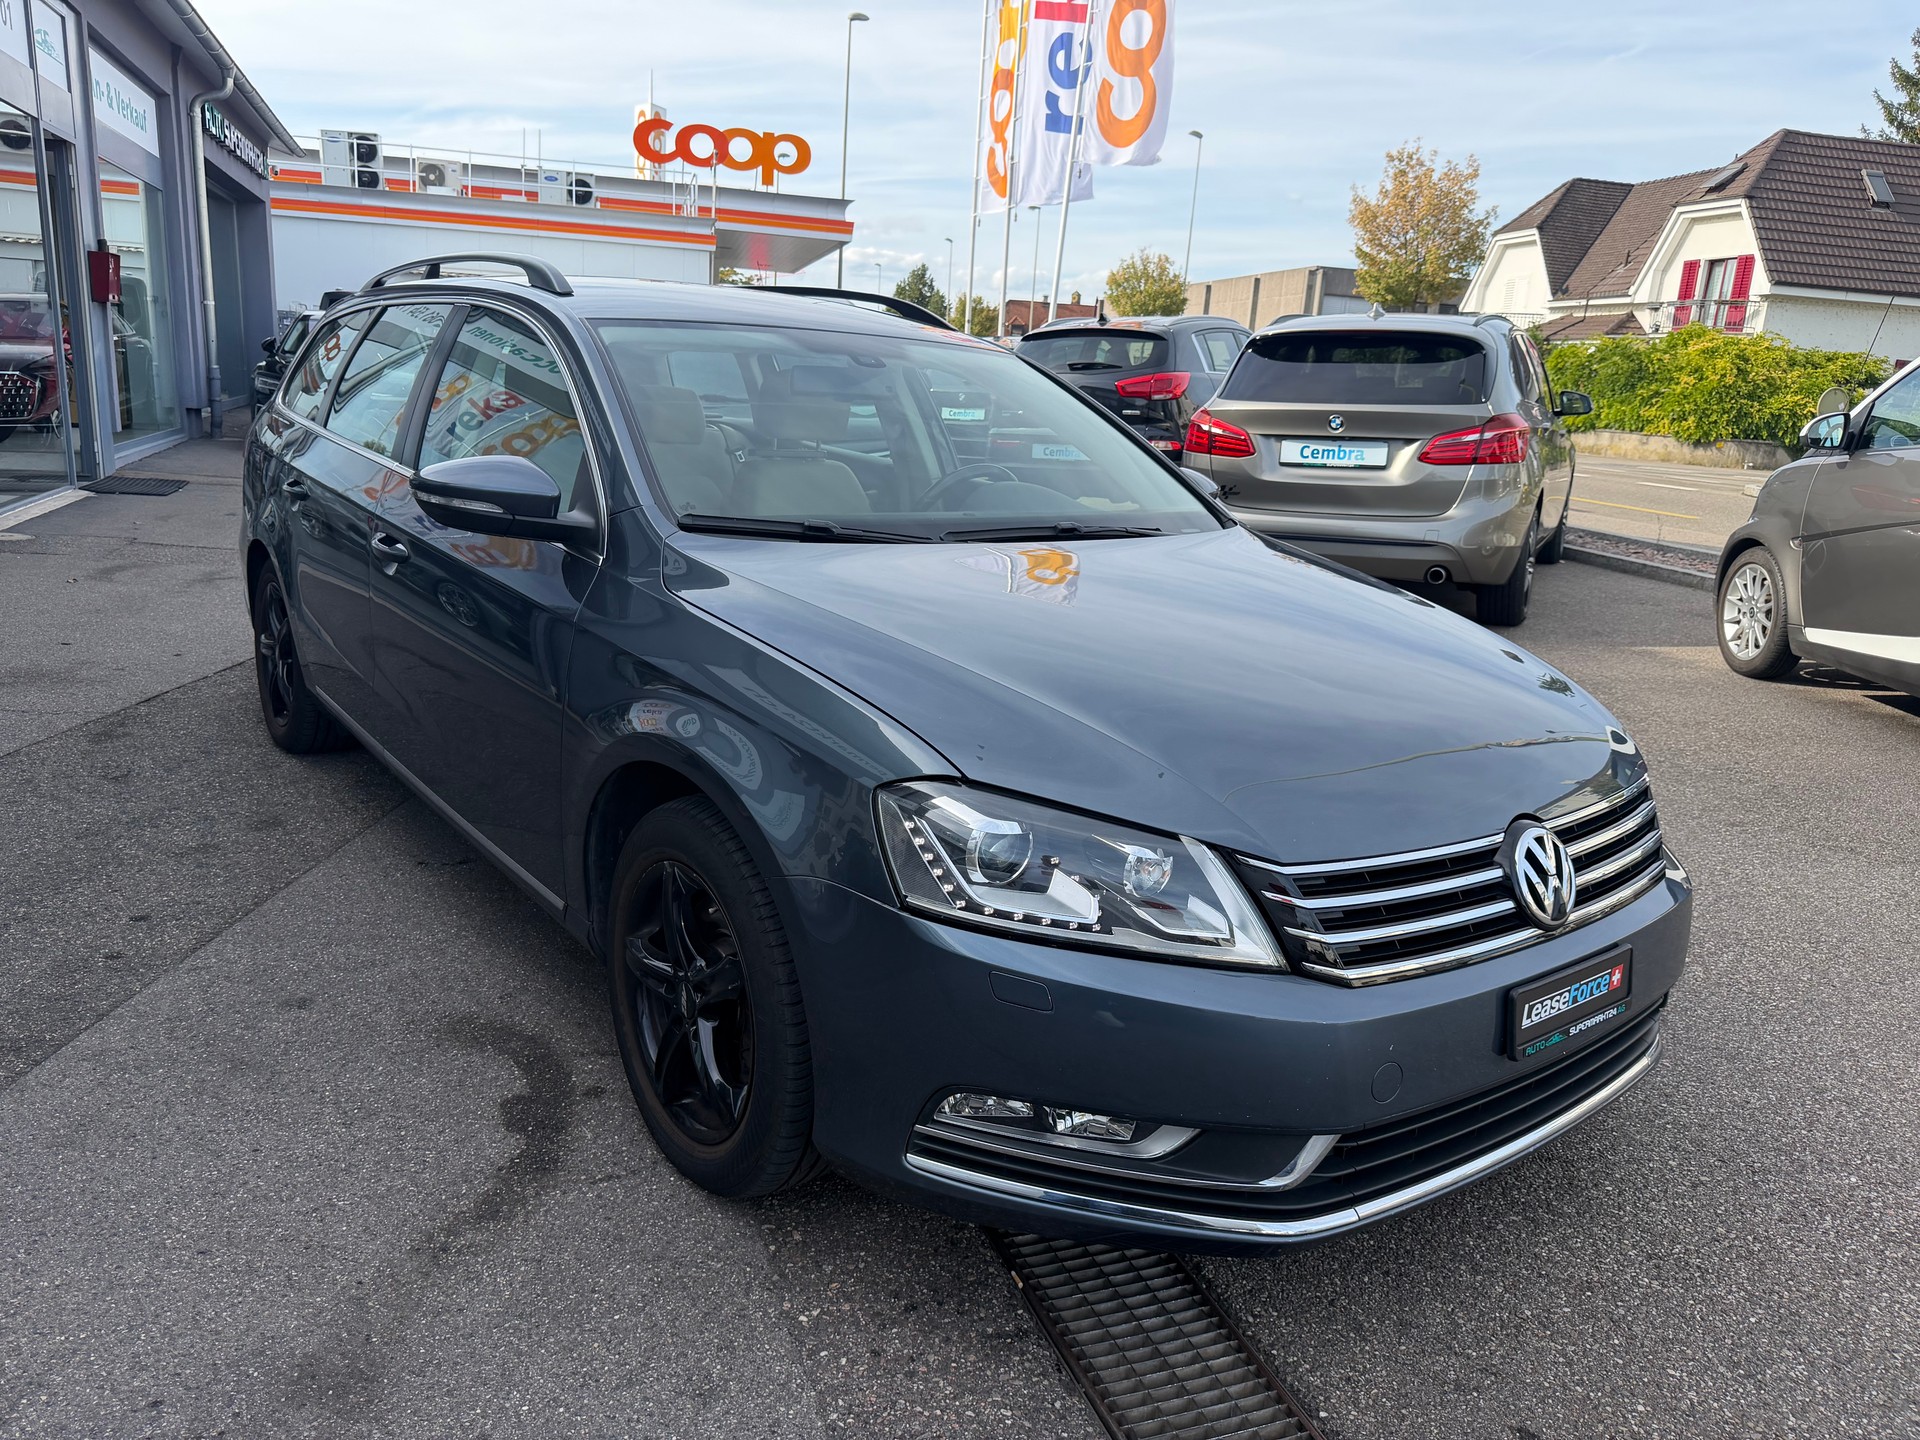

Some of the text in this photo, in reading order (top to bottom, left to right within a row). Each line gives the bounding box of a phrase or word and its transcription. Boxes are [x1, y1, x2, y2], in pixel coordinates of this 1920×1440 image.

[93, 79, 104, 102] n-
[114, 87, 147, 133] Verkauf
[632, 118, 811, 187] coop
[949, 409, 976, 418] Cembra
[1043, 447, 1081, 458] Cembra
[1300, 444, 1366, 461] Cembra
[1521, 974, 1611, 1028] LeaseForce
[1525, 1040, 1546, 1056] AUTO
